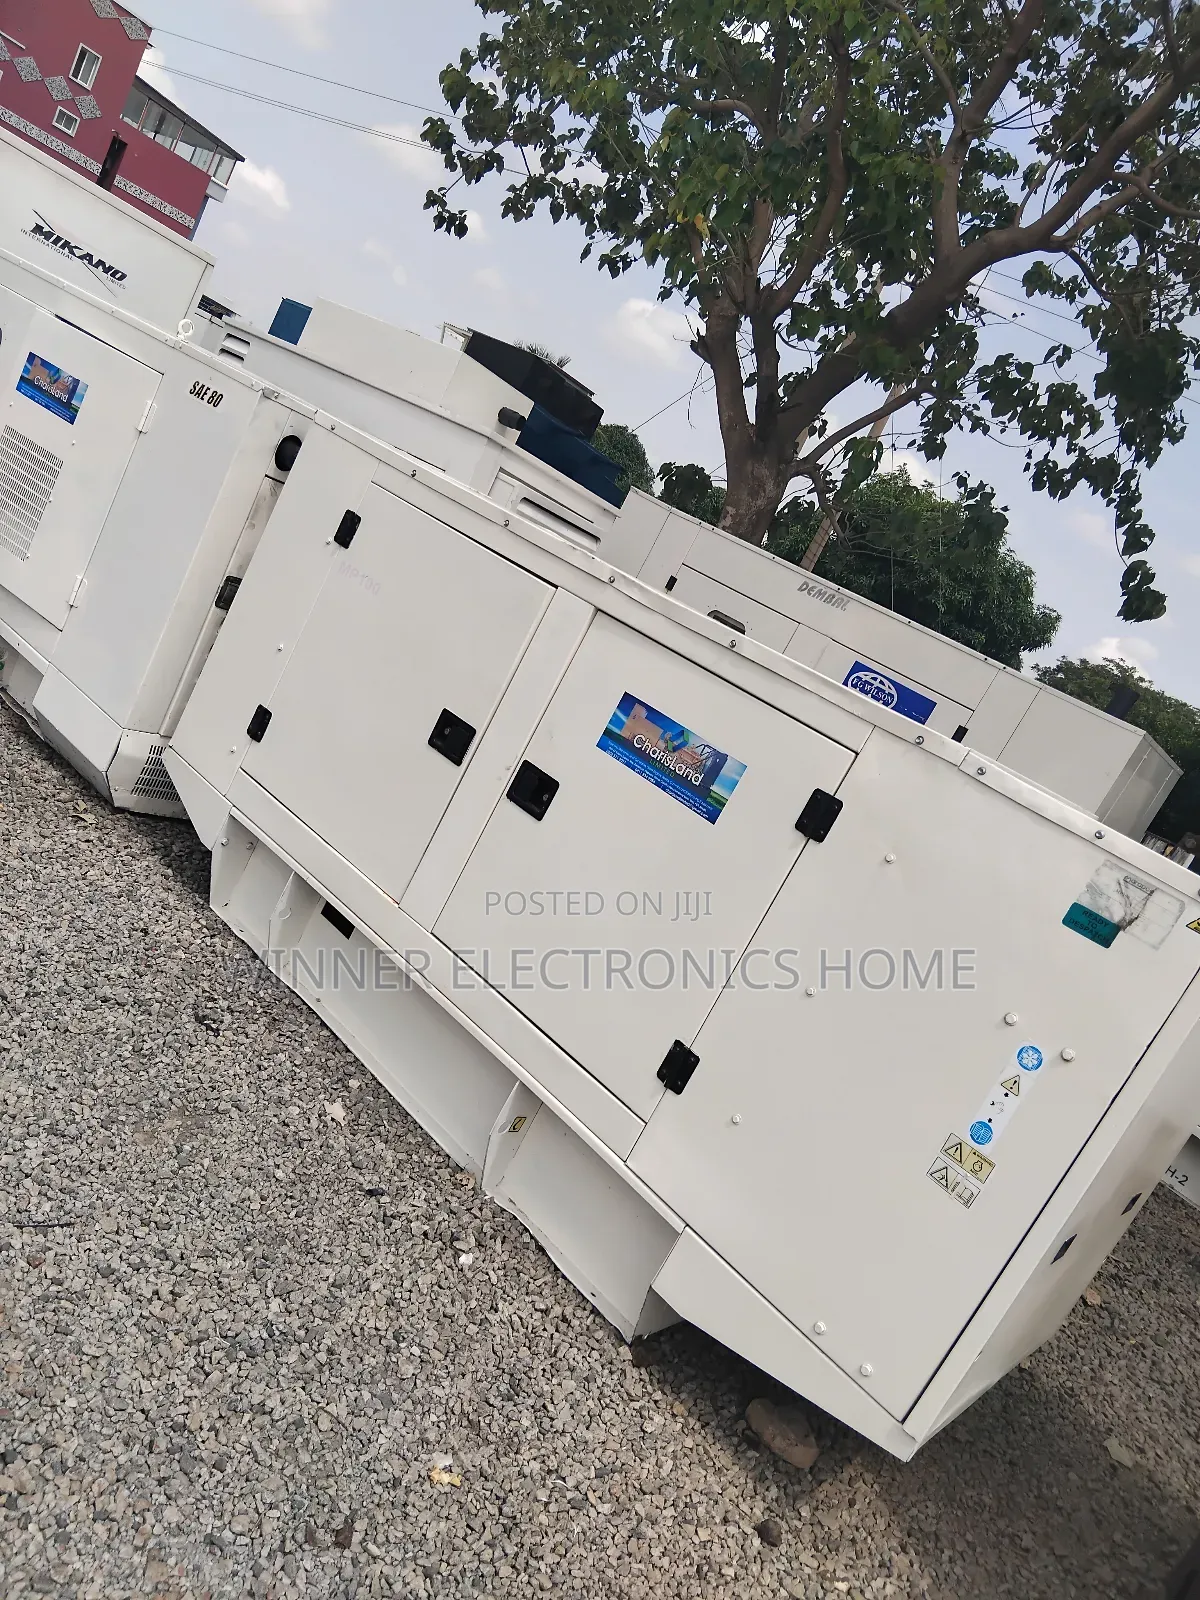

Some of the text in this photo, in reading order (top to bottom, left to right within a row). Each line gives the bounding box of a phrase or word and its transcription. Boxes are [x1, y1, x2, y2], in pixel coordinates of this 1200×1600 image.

[20, 228, 74, 261] INTERNATIONAL
[30, 222, 128, 281] MIKANO
[189, 380, 224, 408] SAE 80
[852, 678, 894, 704] FG WILSON
[633, 734, 704, 786] CharisLand
[649, 758, 675, 779] LIMITED
[1082, 910, 1109, 928] READY
[1087, 919, 1098, 930] TO
